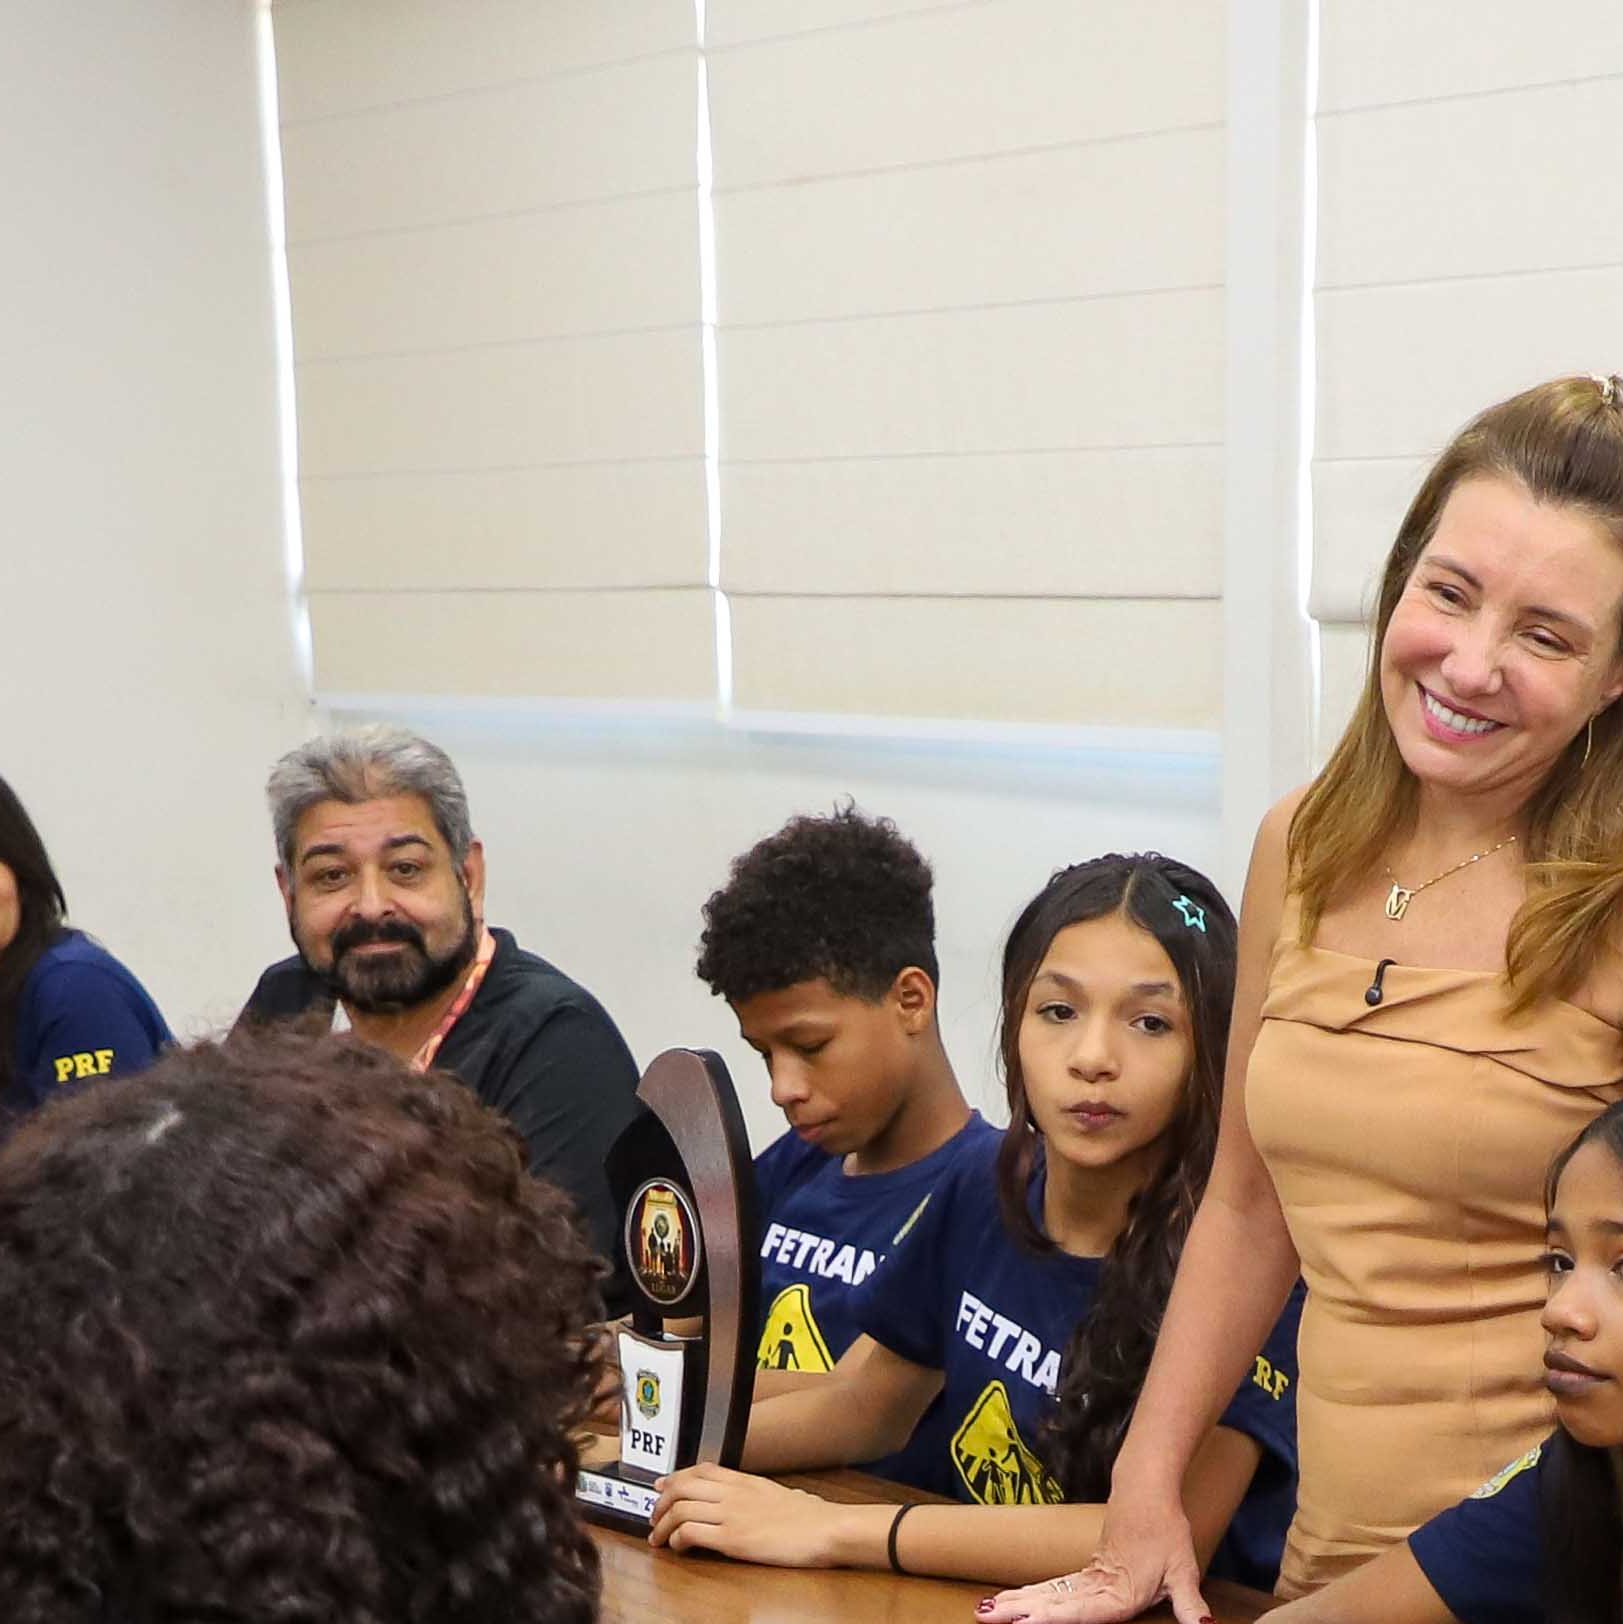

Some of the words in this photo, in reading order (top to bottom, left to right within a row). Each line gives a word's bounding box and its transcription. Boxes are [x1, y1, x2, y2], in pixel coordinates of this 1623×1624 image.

[54, 1050, 114, 1082] PRF
[956, 1290, 1063, 1396] FETRA
[1252, 1354, 1290, 1401] RF
[631, 1428, 665, 1457] PRF
